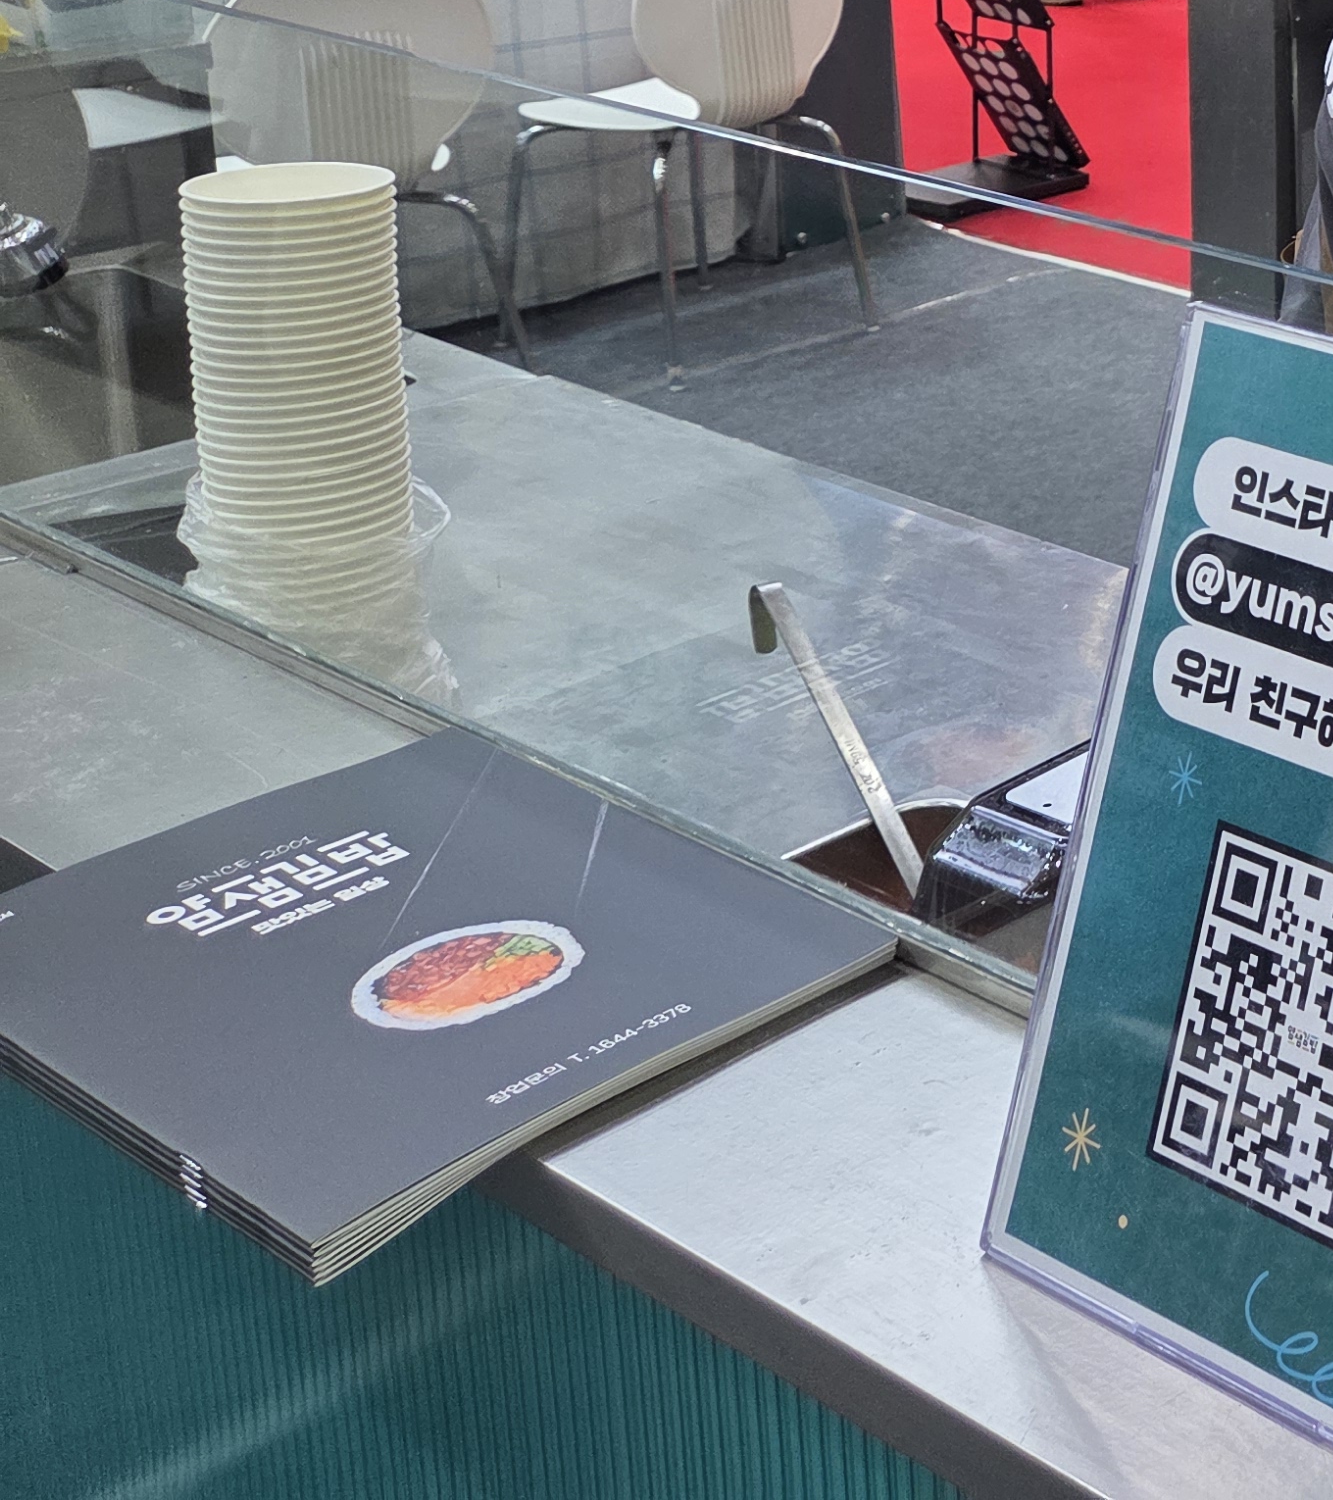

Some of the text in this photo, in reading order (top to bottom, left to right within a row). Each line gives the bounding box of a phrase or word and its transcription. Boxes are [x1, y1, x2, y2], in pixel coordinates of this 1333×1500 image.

[1170, 647, 1241, 713] 우리
[145, 831, 411, 937] 얌샘김밥
[176, 835, 319, 893] SINCE.2001
[486, 1062, 567, 1104] 창업문의
[588, 1003, 692, 1054] 1644-3378
